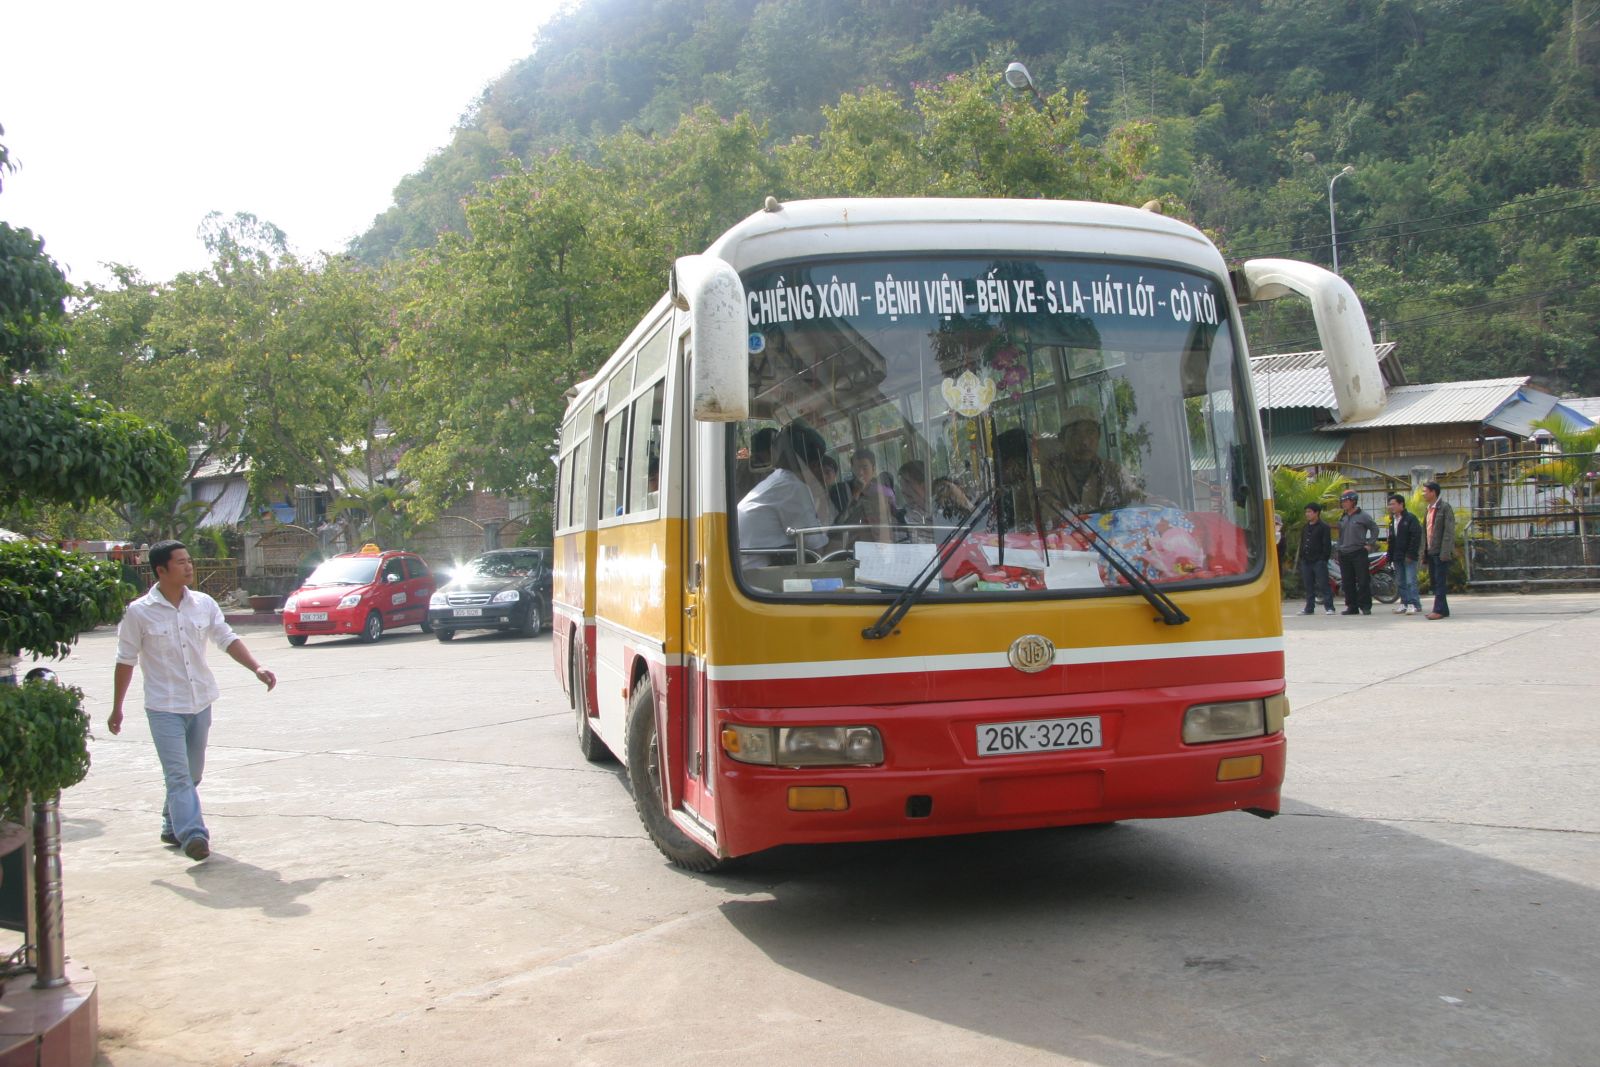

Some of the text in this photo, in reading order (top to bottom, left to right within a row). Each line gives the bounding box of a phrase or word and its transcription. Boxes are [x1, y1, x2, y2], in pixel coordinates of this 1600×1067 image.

[748, 268, 1218, 326] CHIỀNG XÔM BỆNH VIỆN BẾN XE S.LA HÁT LÓT CÒ NÒI
[985, 721, 1094, 752] 26K-3226
